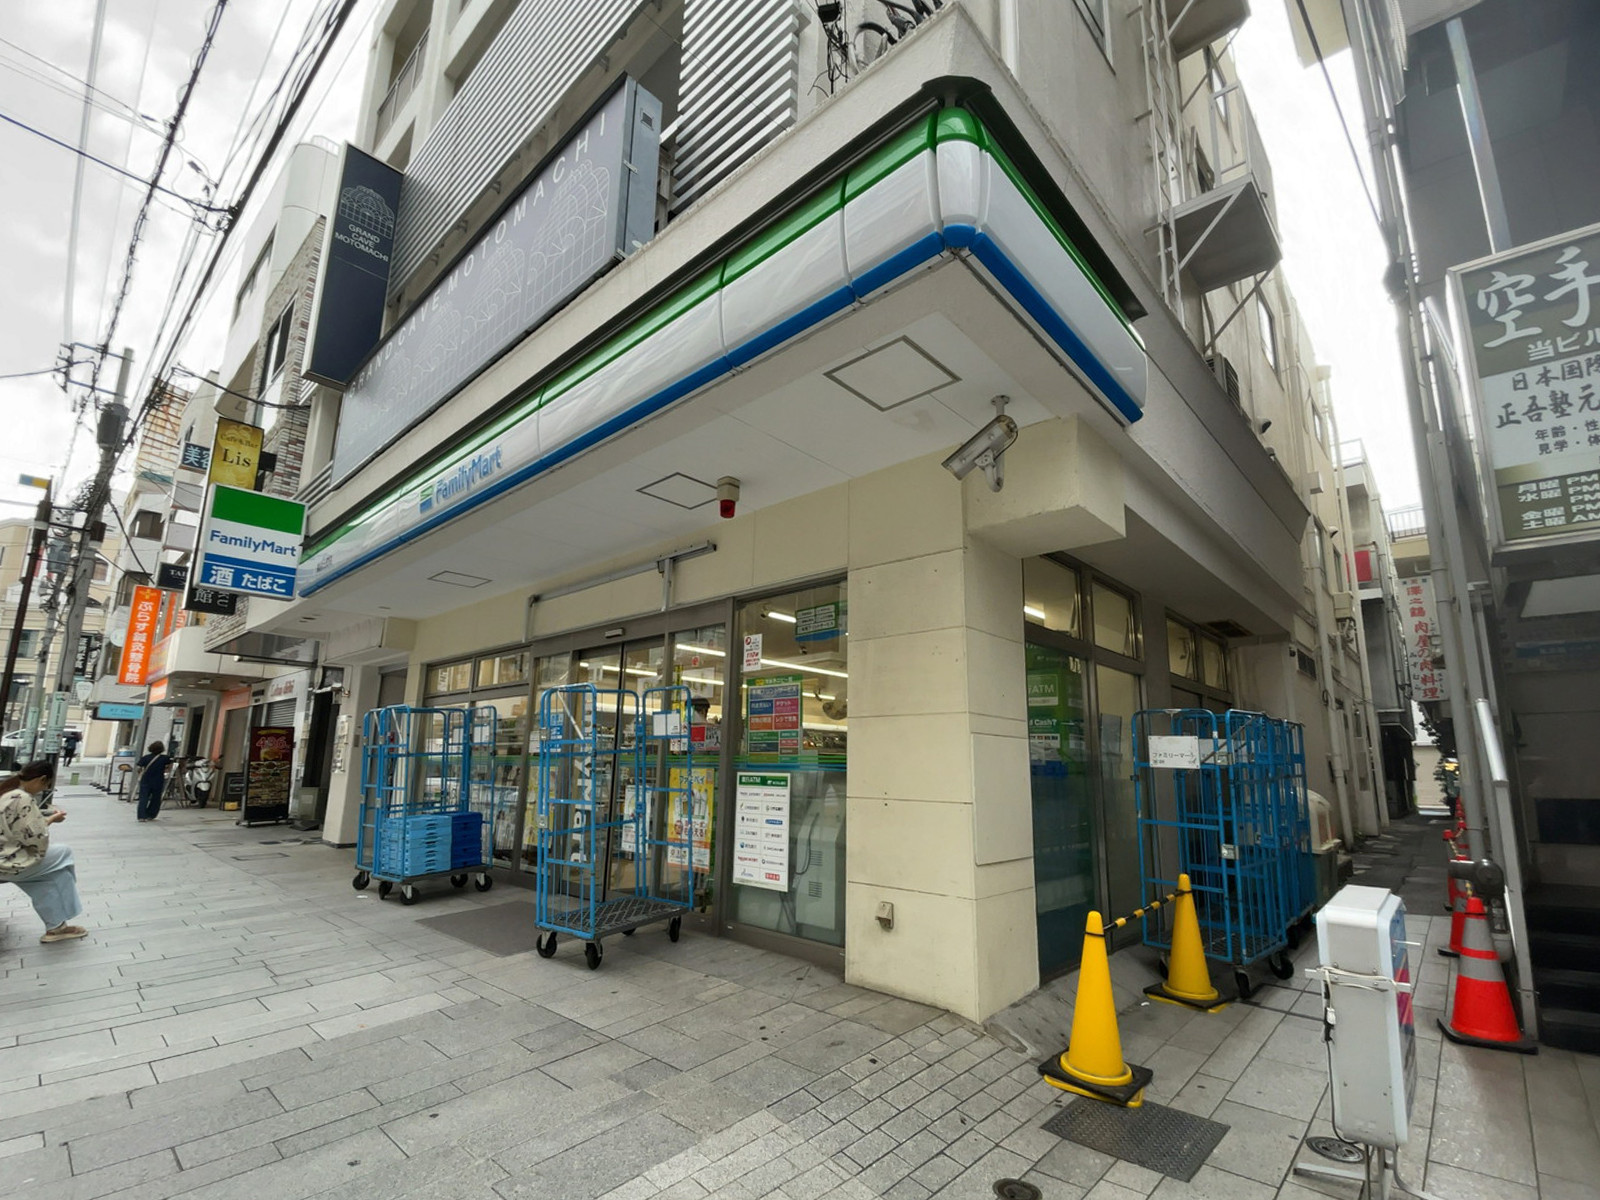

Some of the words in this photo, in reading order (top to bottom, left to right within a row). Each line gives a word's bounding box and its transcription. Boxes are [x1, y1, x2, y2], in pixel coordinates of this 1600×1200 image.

[348, 223, 380, 243] GRAND
[351, 232, 375, 248] CAVE
[335, 232, 389, 262] MOTOMACHI
[350, 342, 392, 398] GRAND
[399, 289, 440, 346] CAVE
[448, 113, 605, 294] MOTOMACHI
[1477, 246, 1600, 348] 空手
[222, 448, 252, 468] Lis
[435, 445, 502, 502] FamilyMart
[1518, 480, 1560, 494] 月曜
[1566, 473, 1599, 485] PM
[1518, 488, 1562, 502] 水曜
[1568, 483, 1600, 494] PM
[1570, 492, 1600, 503] PM
[1522, 506, 1565, 521] 金曜
[1571, 502, 1600, 513] PM
[1522, 516, 1566, 530] 土曜
[209, 529, 297, 557] FamilyMart
[209, 565, 235, 587] 酒
[241, 572, 287, 593] たばこ
